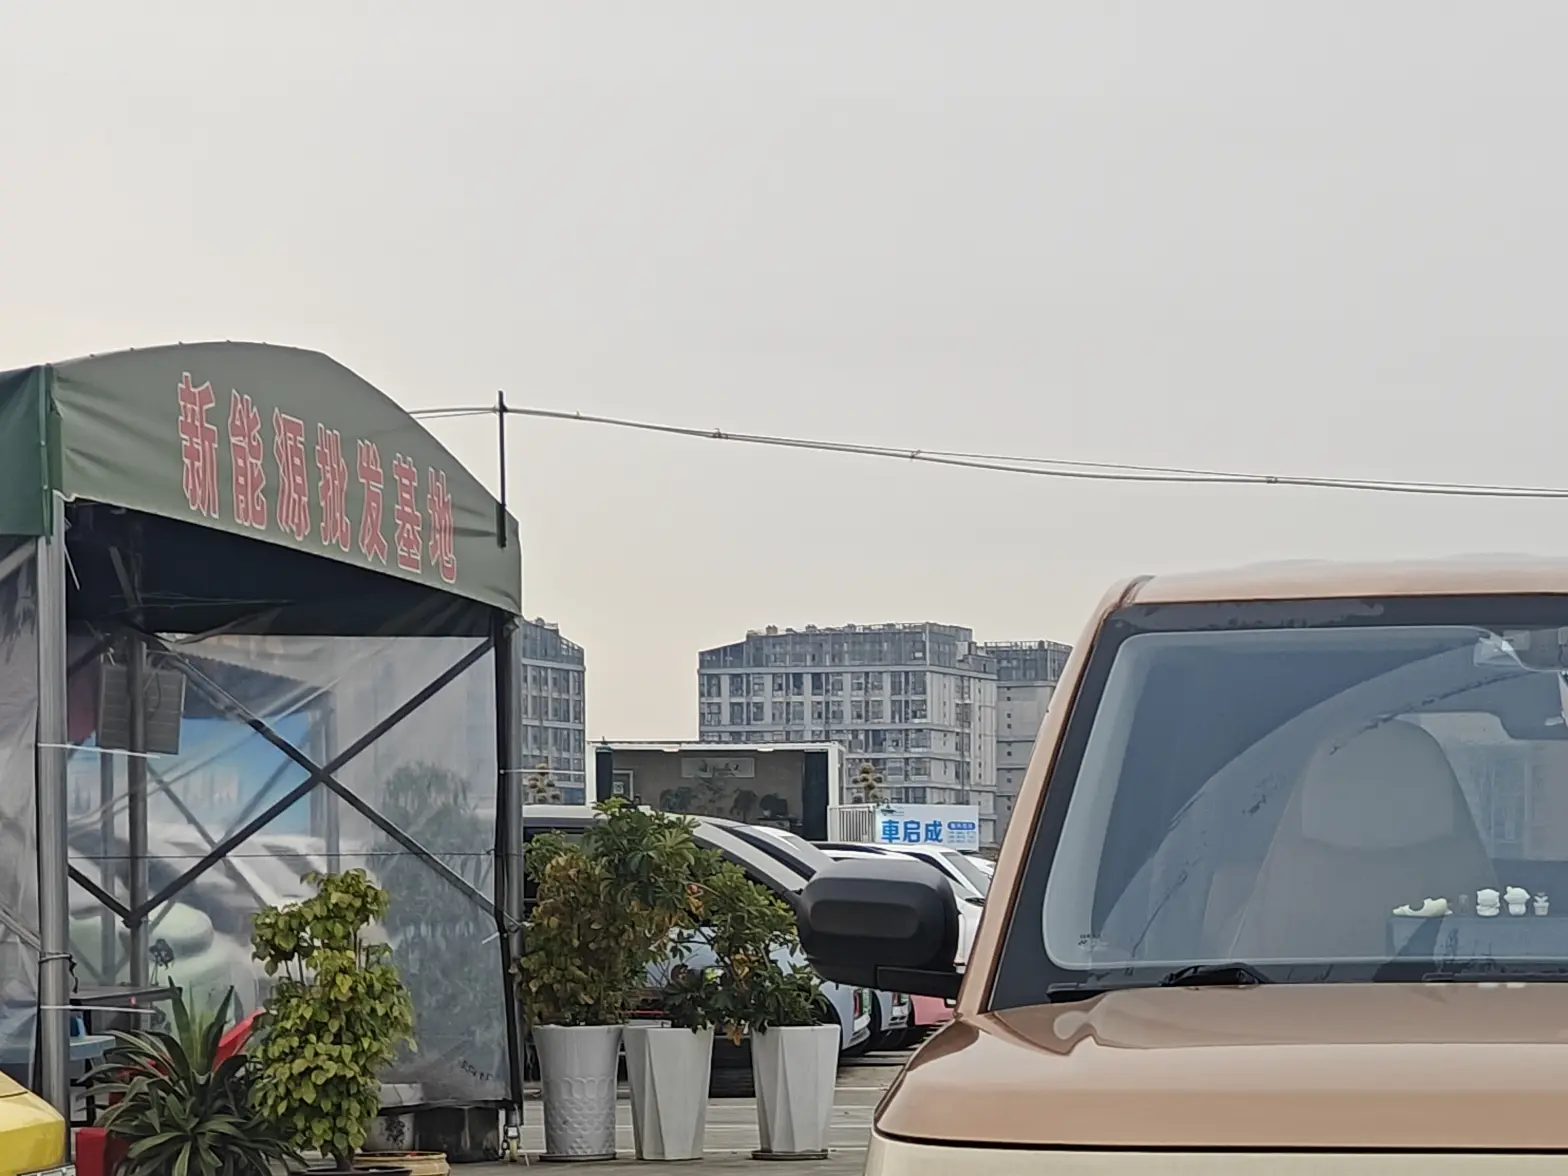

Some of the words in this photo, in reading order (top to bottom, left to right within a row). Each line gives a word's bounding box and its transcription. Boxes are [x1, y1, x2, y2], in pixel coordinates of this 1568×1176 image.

[178, 372, 457, 583] 新能源批发基地
